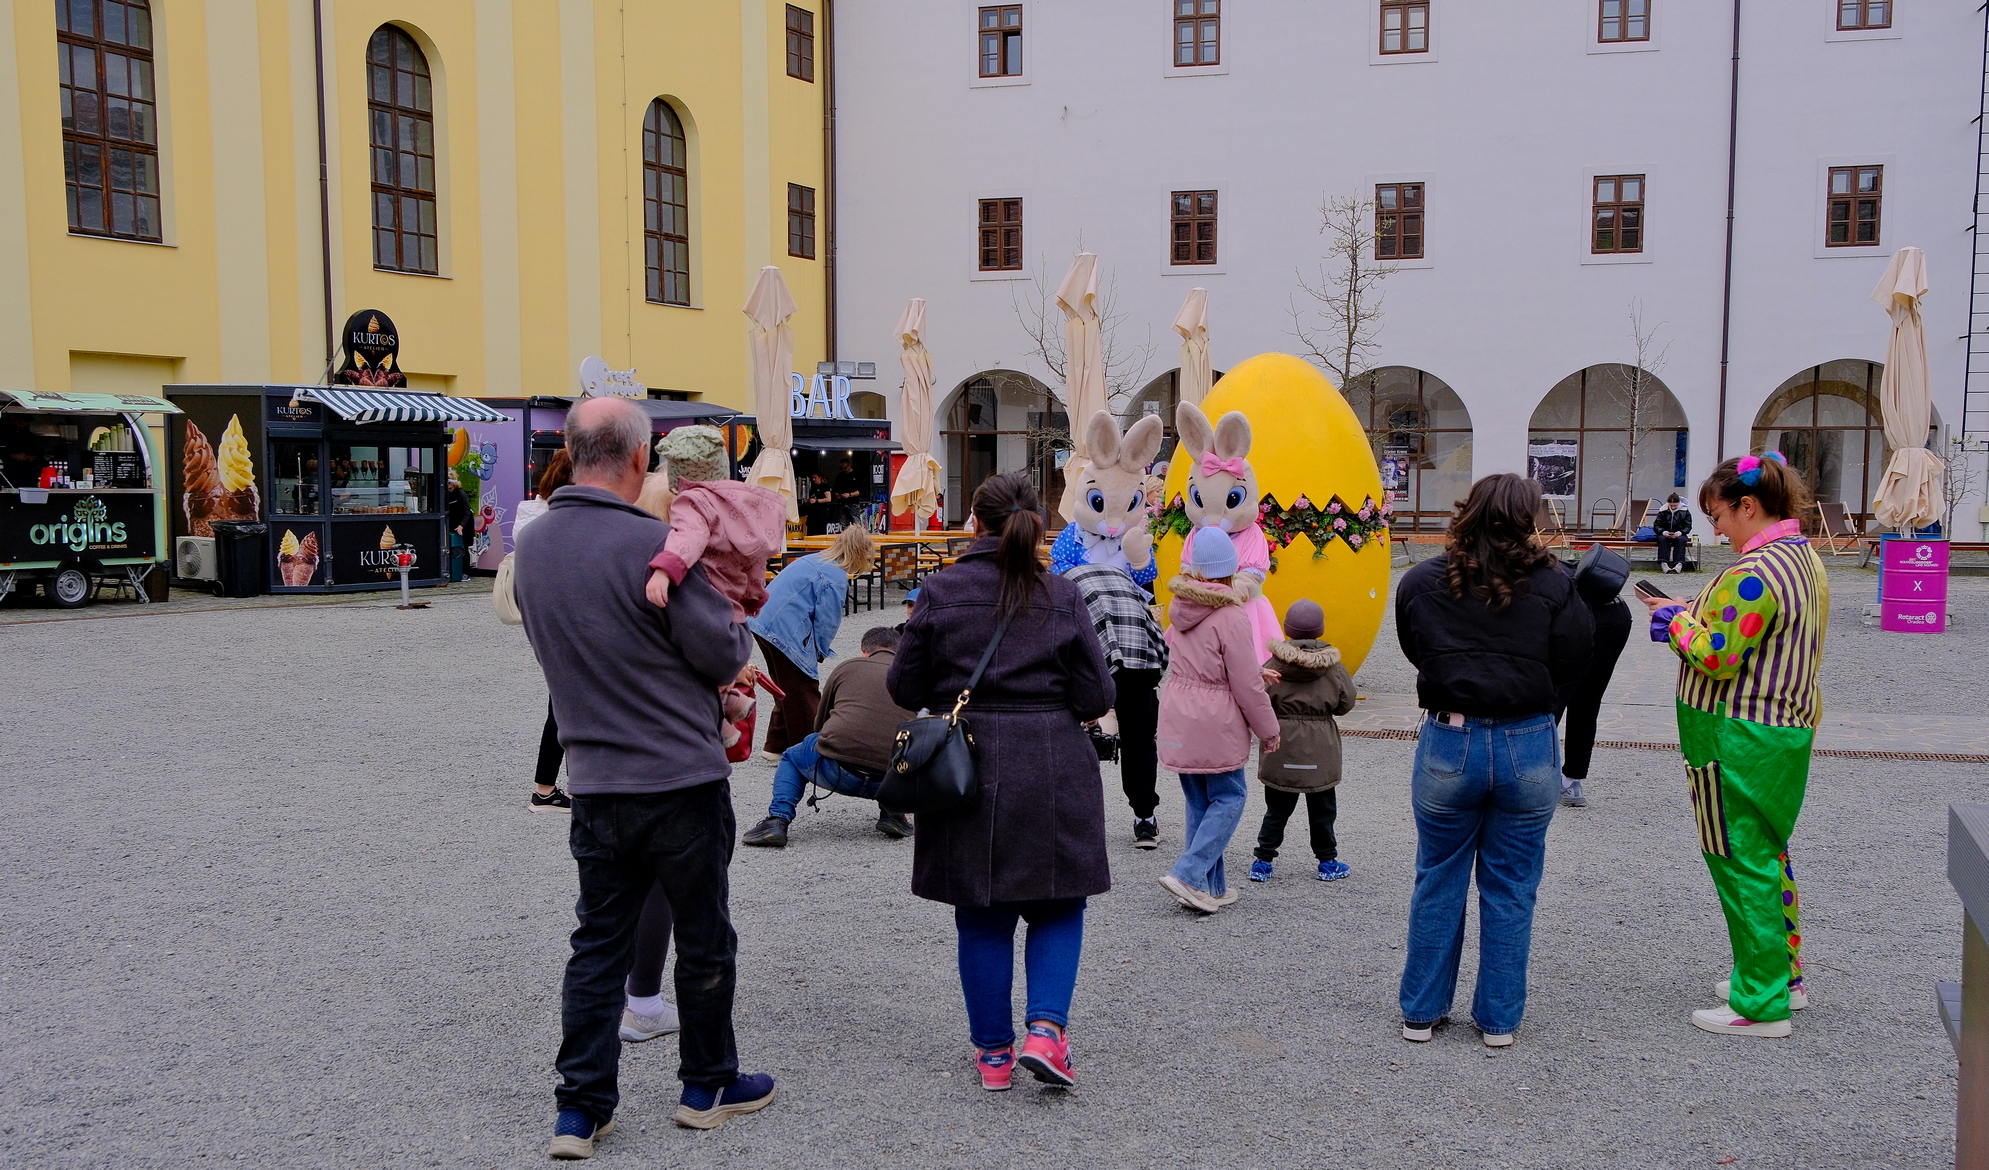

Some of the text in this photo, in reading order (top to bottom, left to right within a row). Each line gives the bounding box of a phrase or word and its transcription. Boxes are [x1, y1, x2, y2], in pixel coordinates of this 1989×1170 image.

[353, 331, 396, 347] KURTOS
[790, 372, 855, 419] BAR
[276, 406, 313, 416] KURTOS
[29, 514, 128, 552] origins
[1913, 581, 1922, 592] X
